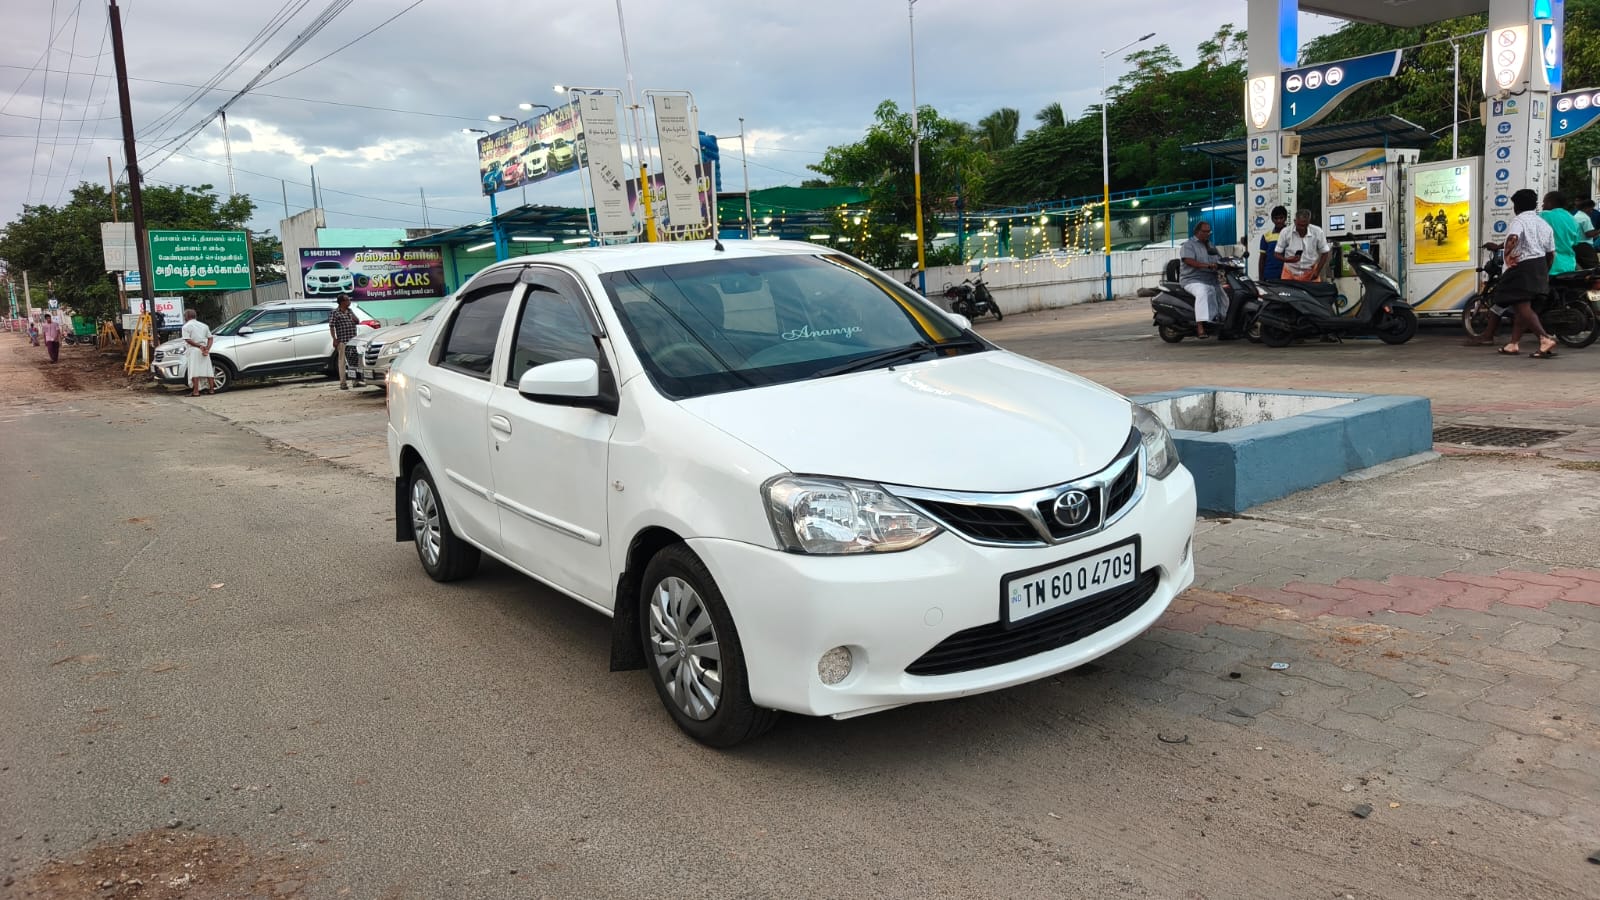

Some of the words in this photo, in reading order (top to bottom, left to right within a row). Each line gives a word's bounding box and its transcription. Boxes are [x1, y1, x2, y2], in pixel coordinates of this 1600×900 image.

[1289, 102, 1297, 117] 1
[1559, 119, 1568, 130] 3
[155, 264, 249, 277] அறிவுத்திருக்கோயில்
[371, 274, 392, 288] SM
[395, 272, 430, 287] CARS
[393, 287, 410, 297] Selling
[781, 324, 863, 341] Ananya
[1023, 579, 1046, 608] TN
[1051, 571, 1072, 599] 60
[1077, 567, 1087, 590] Q
[1091, 552, 1132, 585] 4709
